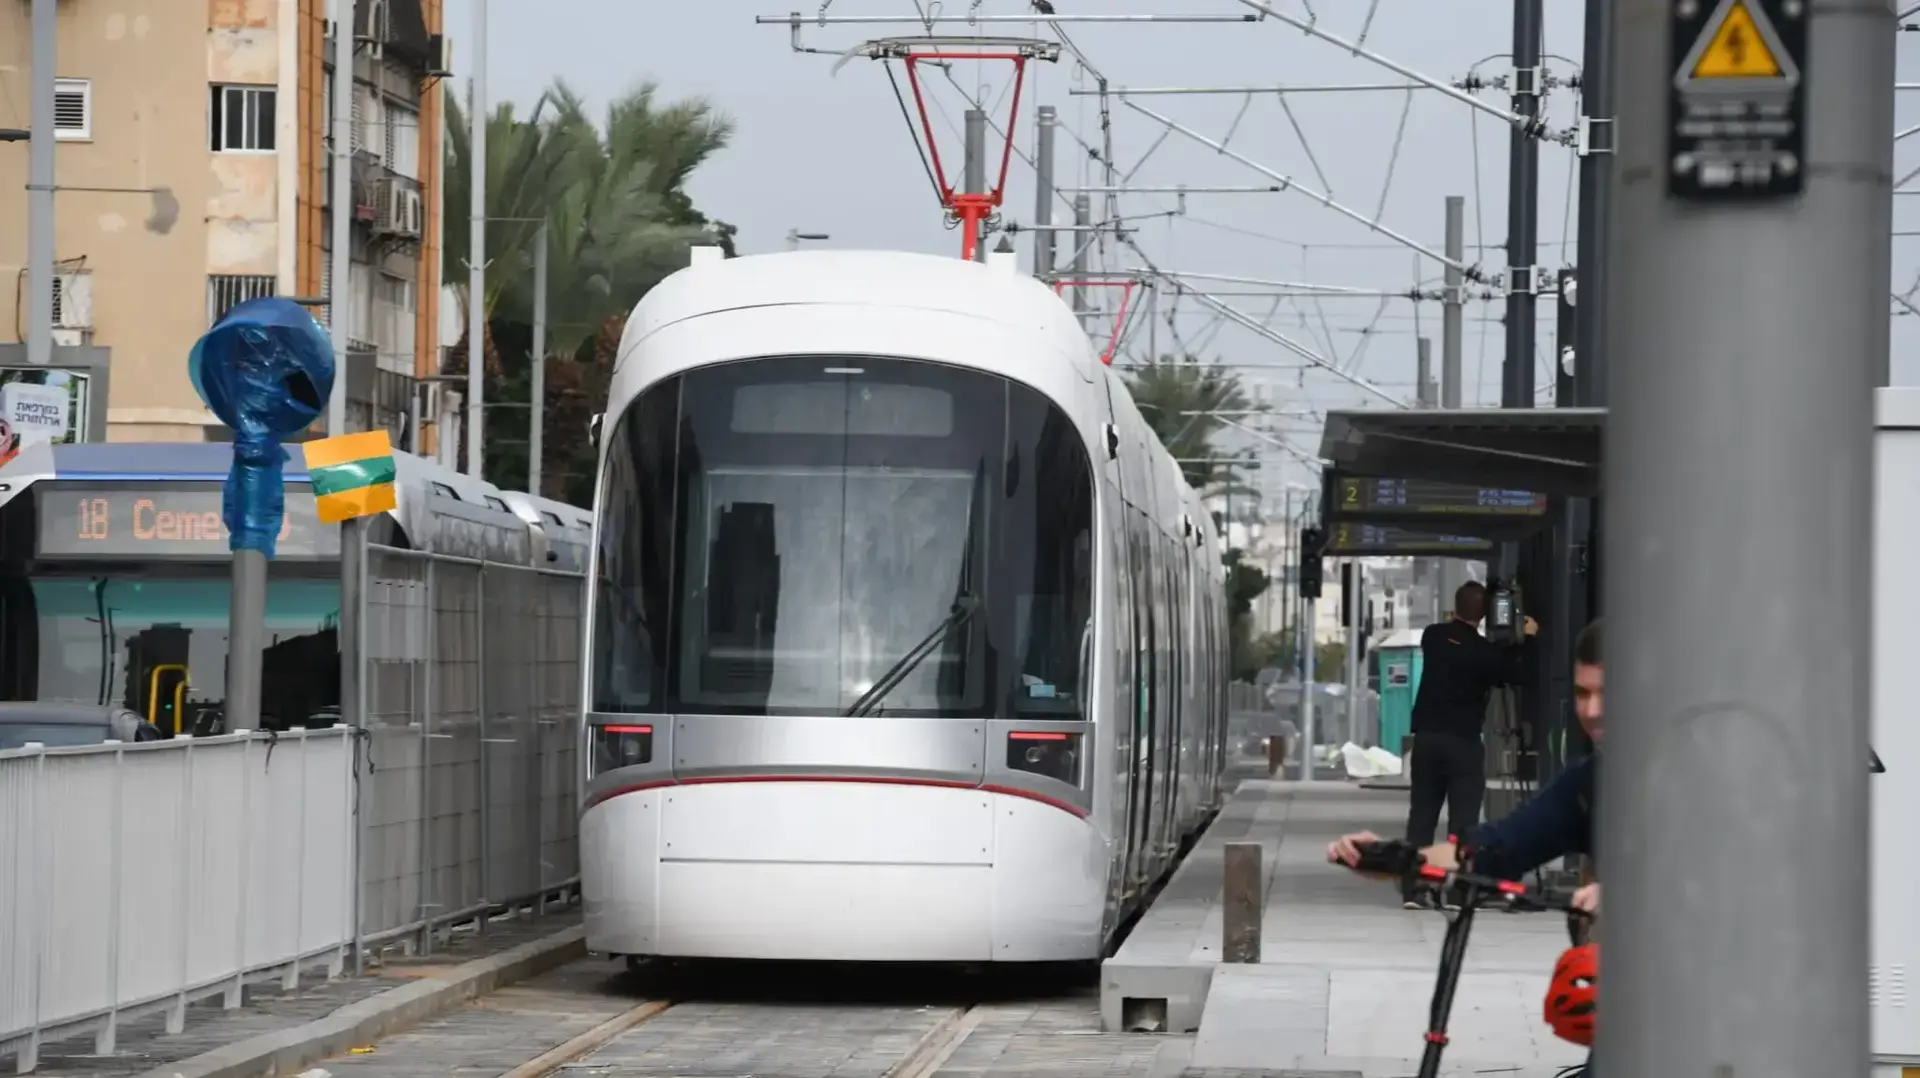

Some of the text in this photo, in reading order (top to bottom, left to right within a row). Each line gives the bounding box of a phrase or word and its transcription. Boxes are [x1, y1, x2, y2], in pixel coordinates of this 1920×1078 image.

[1346, 486, 1358, 502] 2
[78, 498, 109, 540] 18
[1338, 529, 1348, 542] 2
